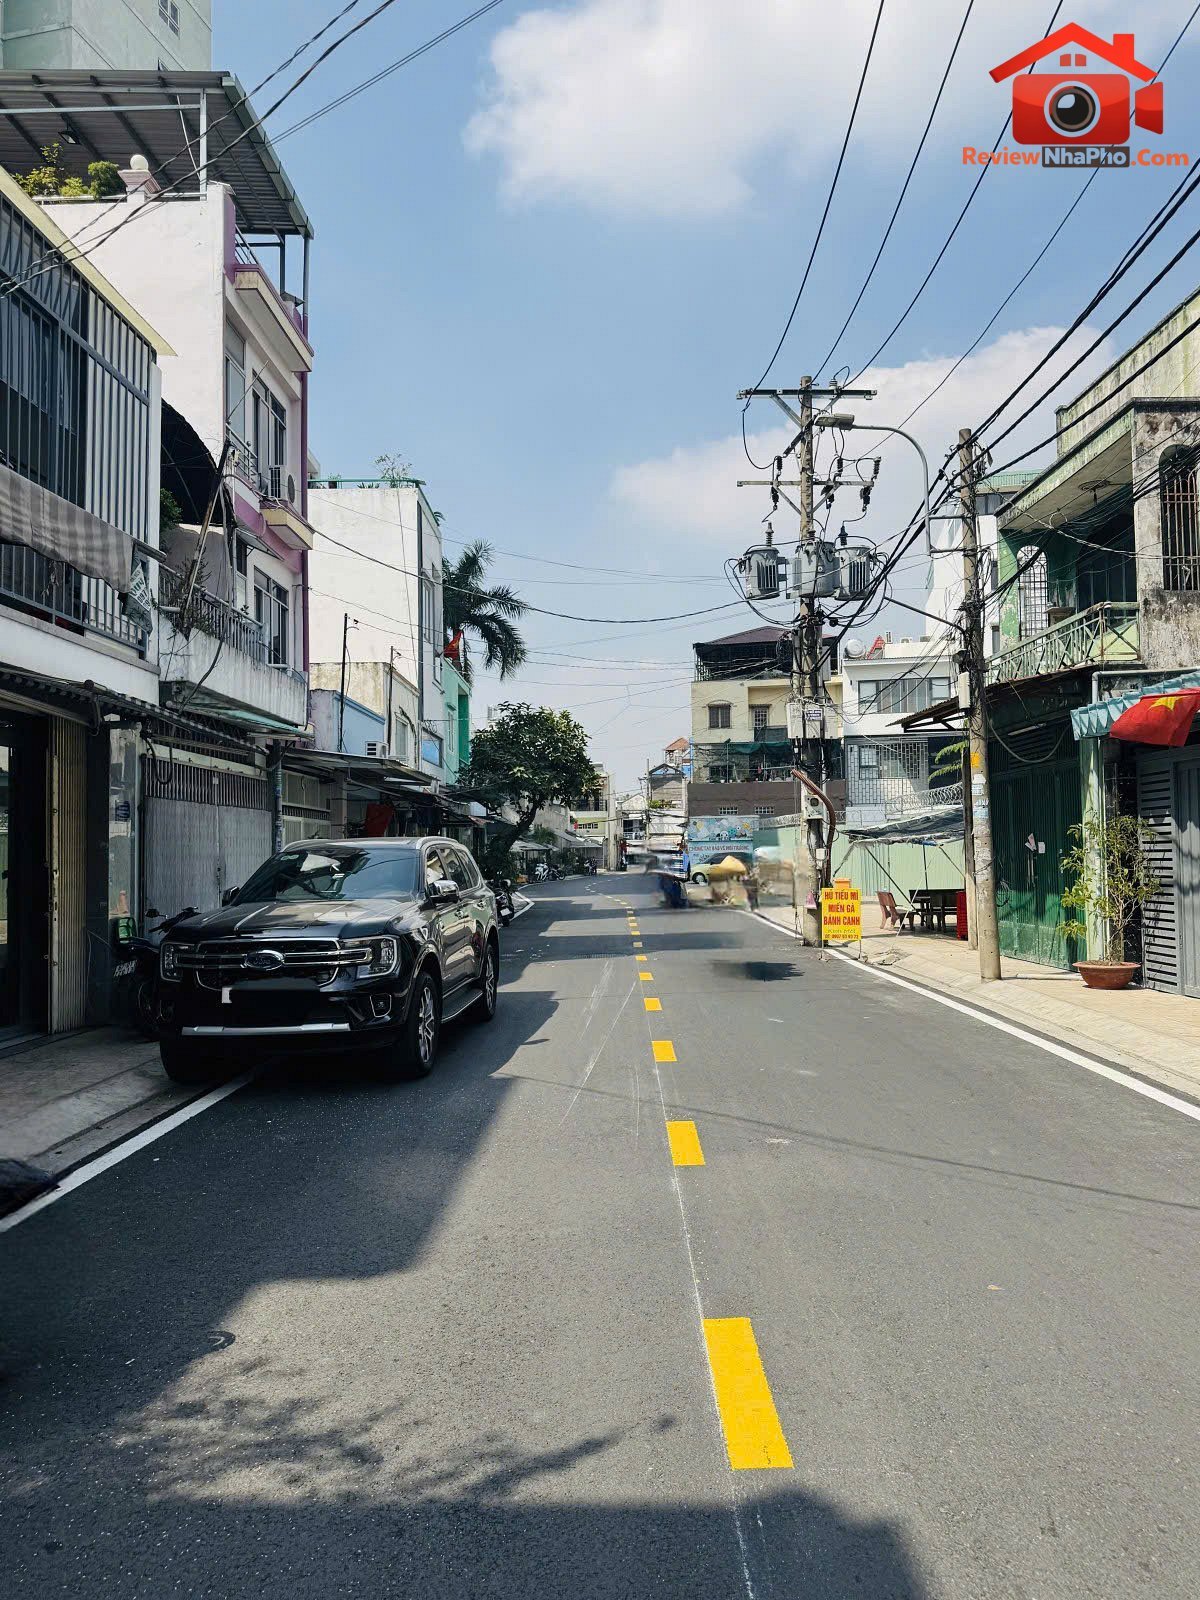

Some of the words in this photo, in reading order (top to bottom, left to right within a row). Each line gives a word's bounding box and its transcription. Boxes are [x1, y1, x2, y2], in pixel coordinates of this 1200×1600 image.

[846, 903, 855, 912] GÀ
[824, 915, 840, 925] BÁNH
[843, 916, 860, 925] CANH
